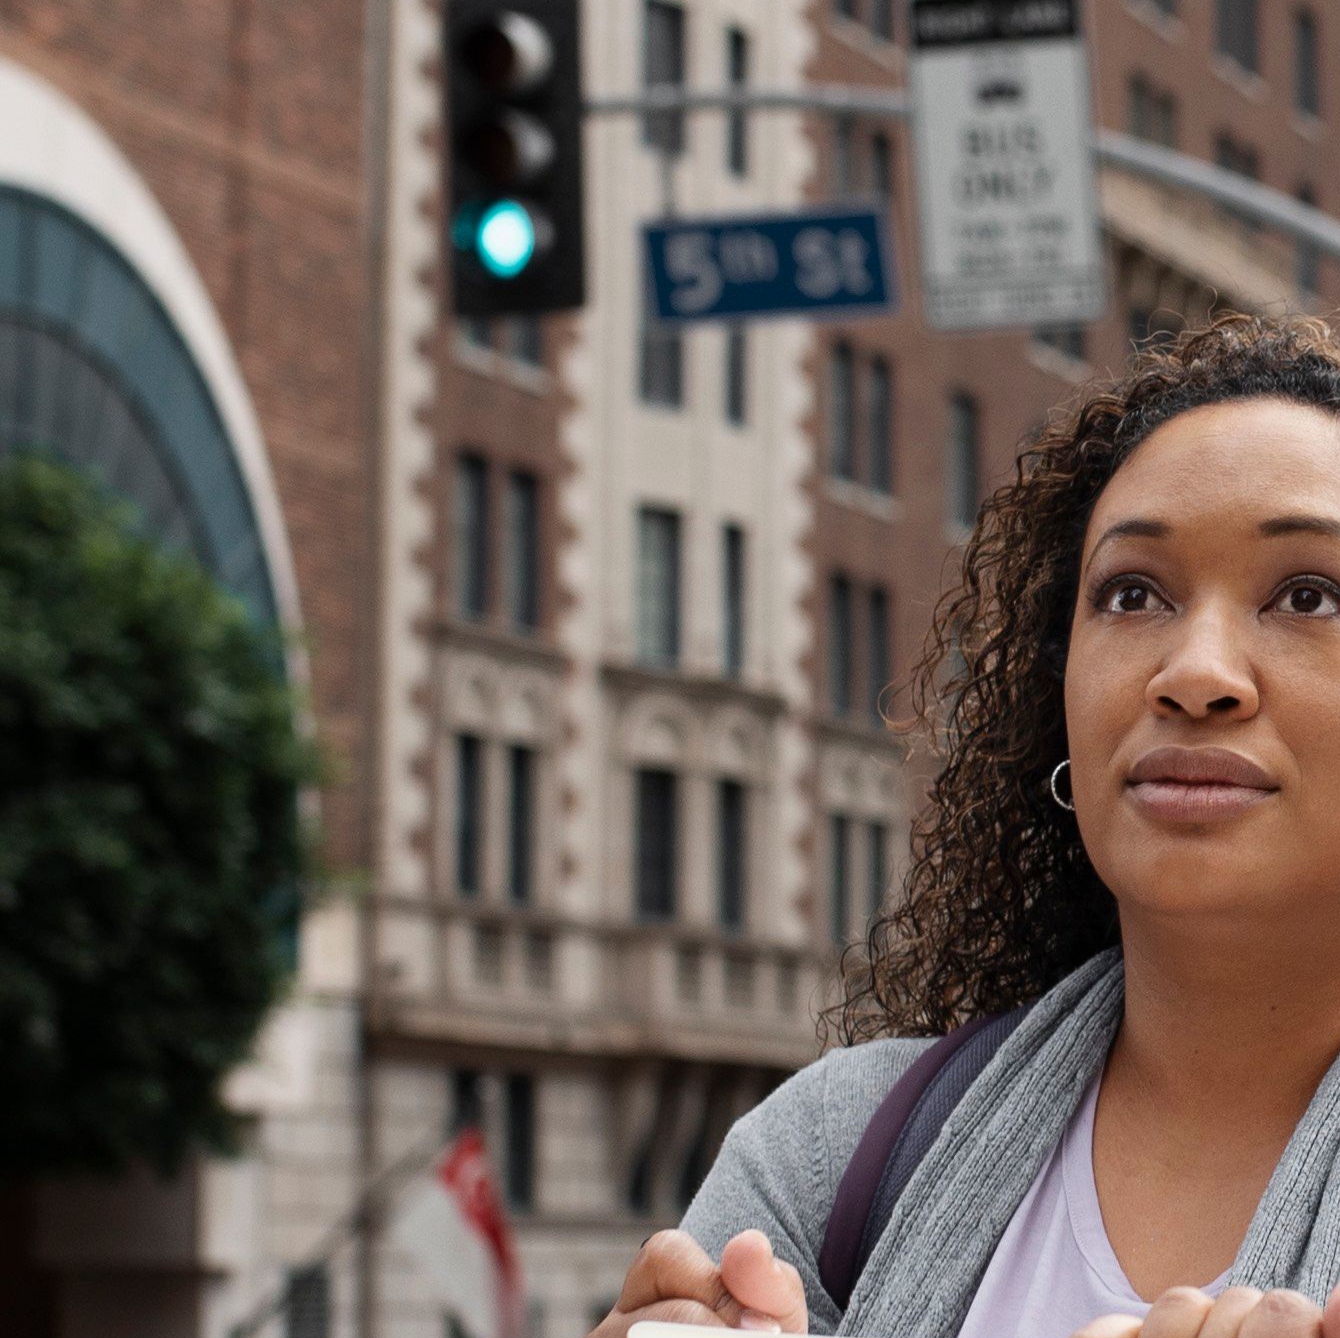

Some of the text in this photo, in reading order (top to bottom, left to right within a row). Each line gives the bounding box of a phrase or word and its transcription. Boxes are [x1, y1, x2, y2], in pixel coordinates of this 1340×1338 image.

[962, 120, 1042, 163] BUS
[955, 165, 1053, 206] ONLY
[795, 230, 872, 297] St
